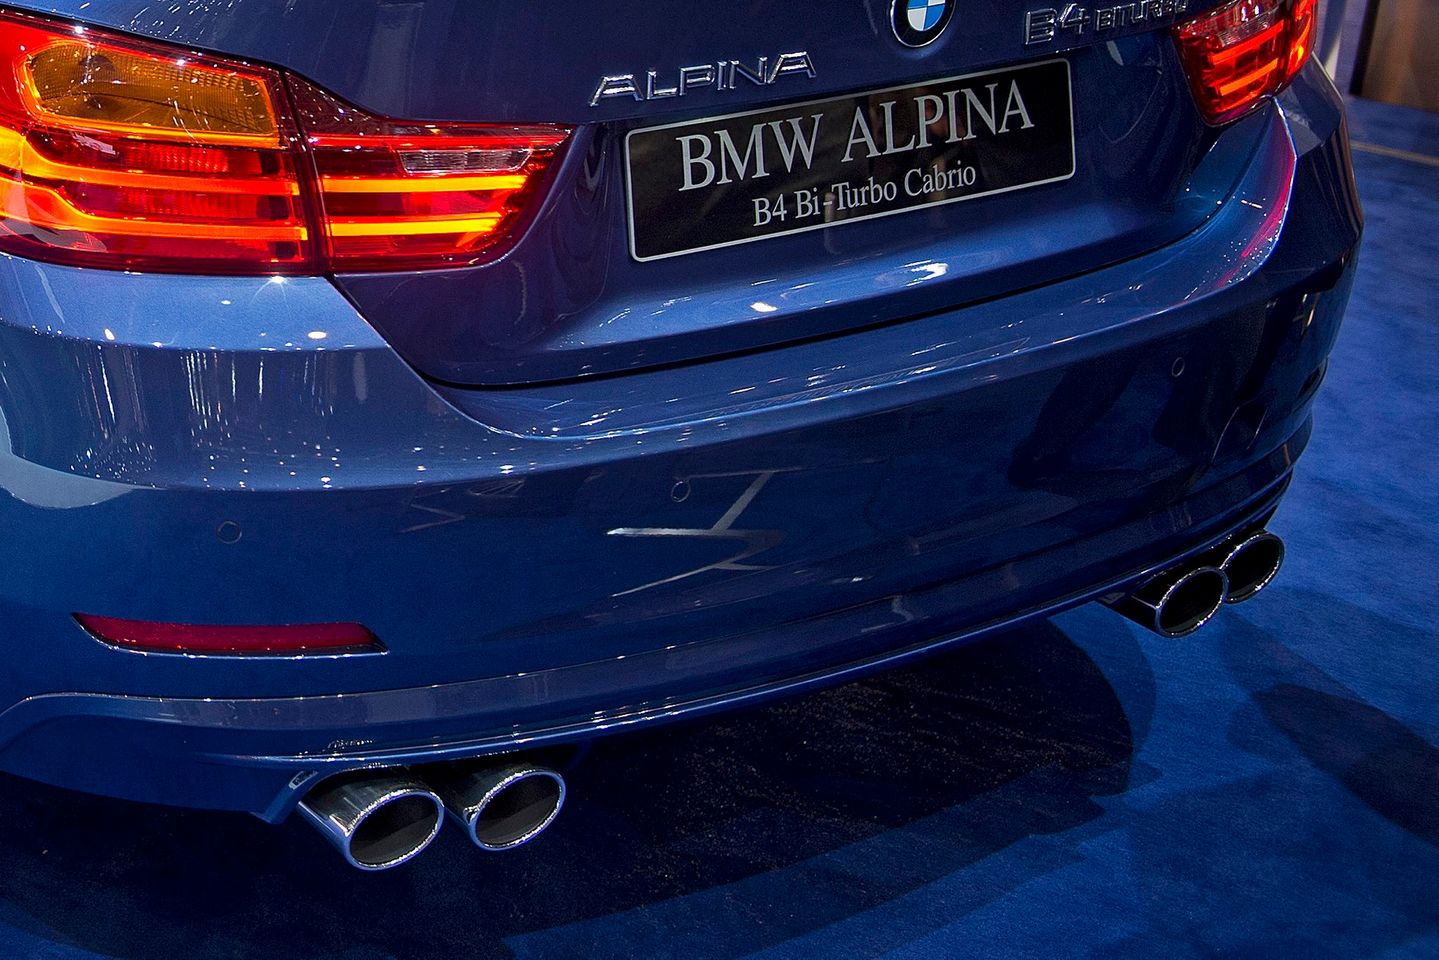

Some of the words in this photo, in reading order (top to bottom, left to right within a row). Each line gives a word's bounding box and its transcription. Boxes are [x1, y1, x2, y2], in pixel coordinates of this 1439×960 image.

[1023, 2, 1090, 46] B4
[588, 50, 817, 107] ALPINA
[675, 113, 824, 192] BMW
[841, 79, 1035, 163] ALPINA
[753, 197, 788, 228] B4
[795, 177, 898, 220] Bi-Turbo
[904, 160, 977, 197] Cabrio
